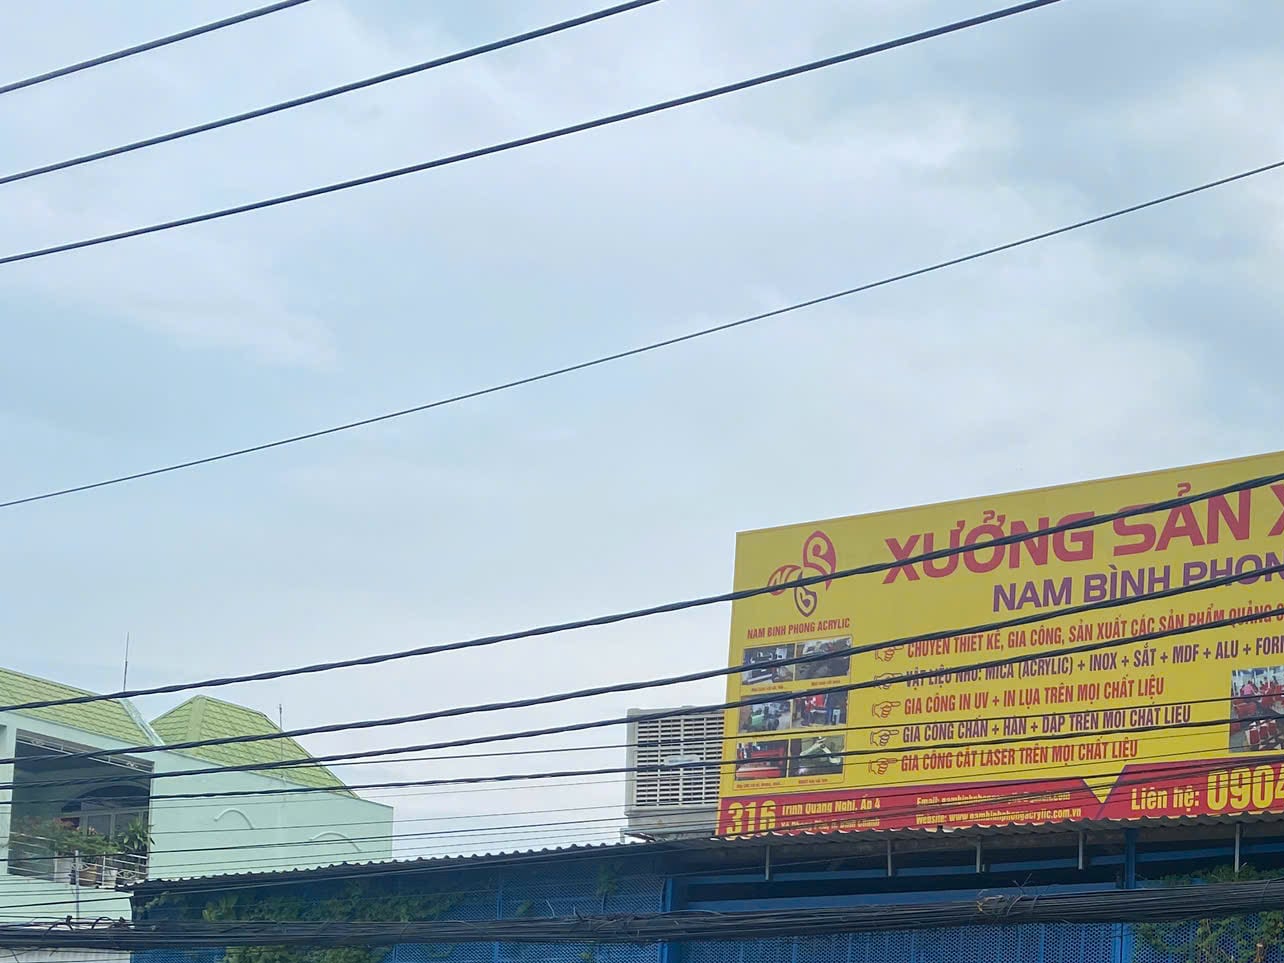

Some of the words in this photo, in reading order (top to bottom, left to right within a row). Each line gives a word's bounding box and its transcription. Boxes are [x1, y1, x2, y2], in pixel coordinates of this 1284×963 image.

[882, 510, 1095, 584] XƯỞNG
[1113, 482, 1250, 556] SẢN
[993, 577, 1072, 612] NAM
[1083, 564, 1170, 603] BÌNH
[747, 628, 765, 639] NAM
[788, 622, 815, 635] PHONG
[817, 618, 850, 631] ACRYLIC
[1008, 630, 1026, 648] GIA
[1030, 625, 1065, 646] CÔNG,
[1068, 619, 1093, 643] SẢN
[1097, 614, 1127, 640] XUẤT
[1131, 615, 1155, 638] CÁC
[1159, 609, 1184, 632] SẢN
[985, 663, 1014, 680] MICA
[1018, 656, 1073, 680] (ACRYLIC)
[1090, 652, 1117, 671] INOX
[1134, 642, 1156, 668] SẮT
[1172, 644, 1199, 664] MDF
[1215, 640, 1239, 659] ALU
[904, 698, 922, 715] GIA
[926, 692, 955, 713] CÔNG
[959, 693, 971, 710] IN
[974, 692, 988, 709] UV
[1003, 690, 1015, 707] IN
[1044, 683, 1074, 704] TRÊN
[1077, 683, 1099, 704] MỌI
[1103, 674, 1134, 700] CHẤT
[1138, 674, 1164, 700] LIỆU
[901, 754, 919, 771] GIA
[922, 750, 952, 770] CÔNG
[980, 748, 1015, 766] LASER
[1019, 743, 1048, 764] TRÊN
[1051, 744, 1074, 766] MỌI
[1078, 736, 1109, 761] CHẤT
[902, 726, 920, 743] GIA
[1131, 788, 1168, 811] Liên
[1173, 785, 1199, 813] hệ:
[726, 800, 777, 840] 316
